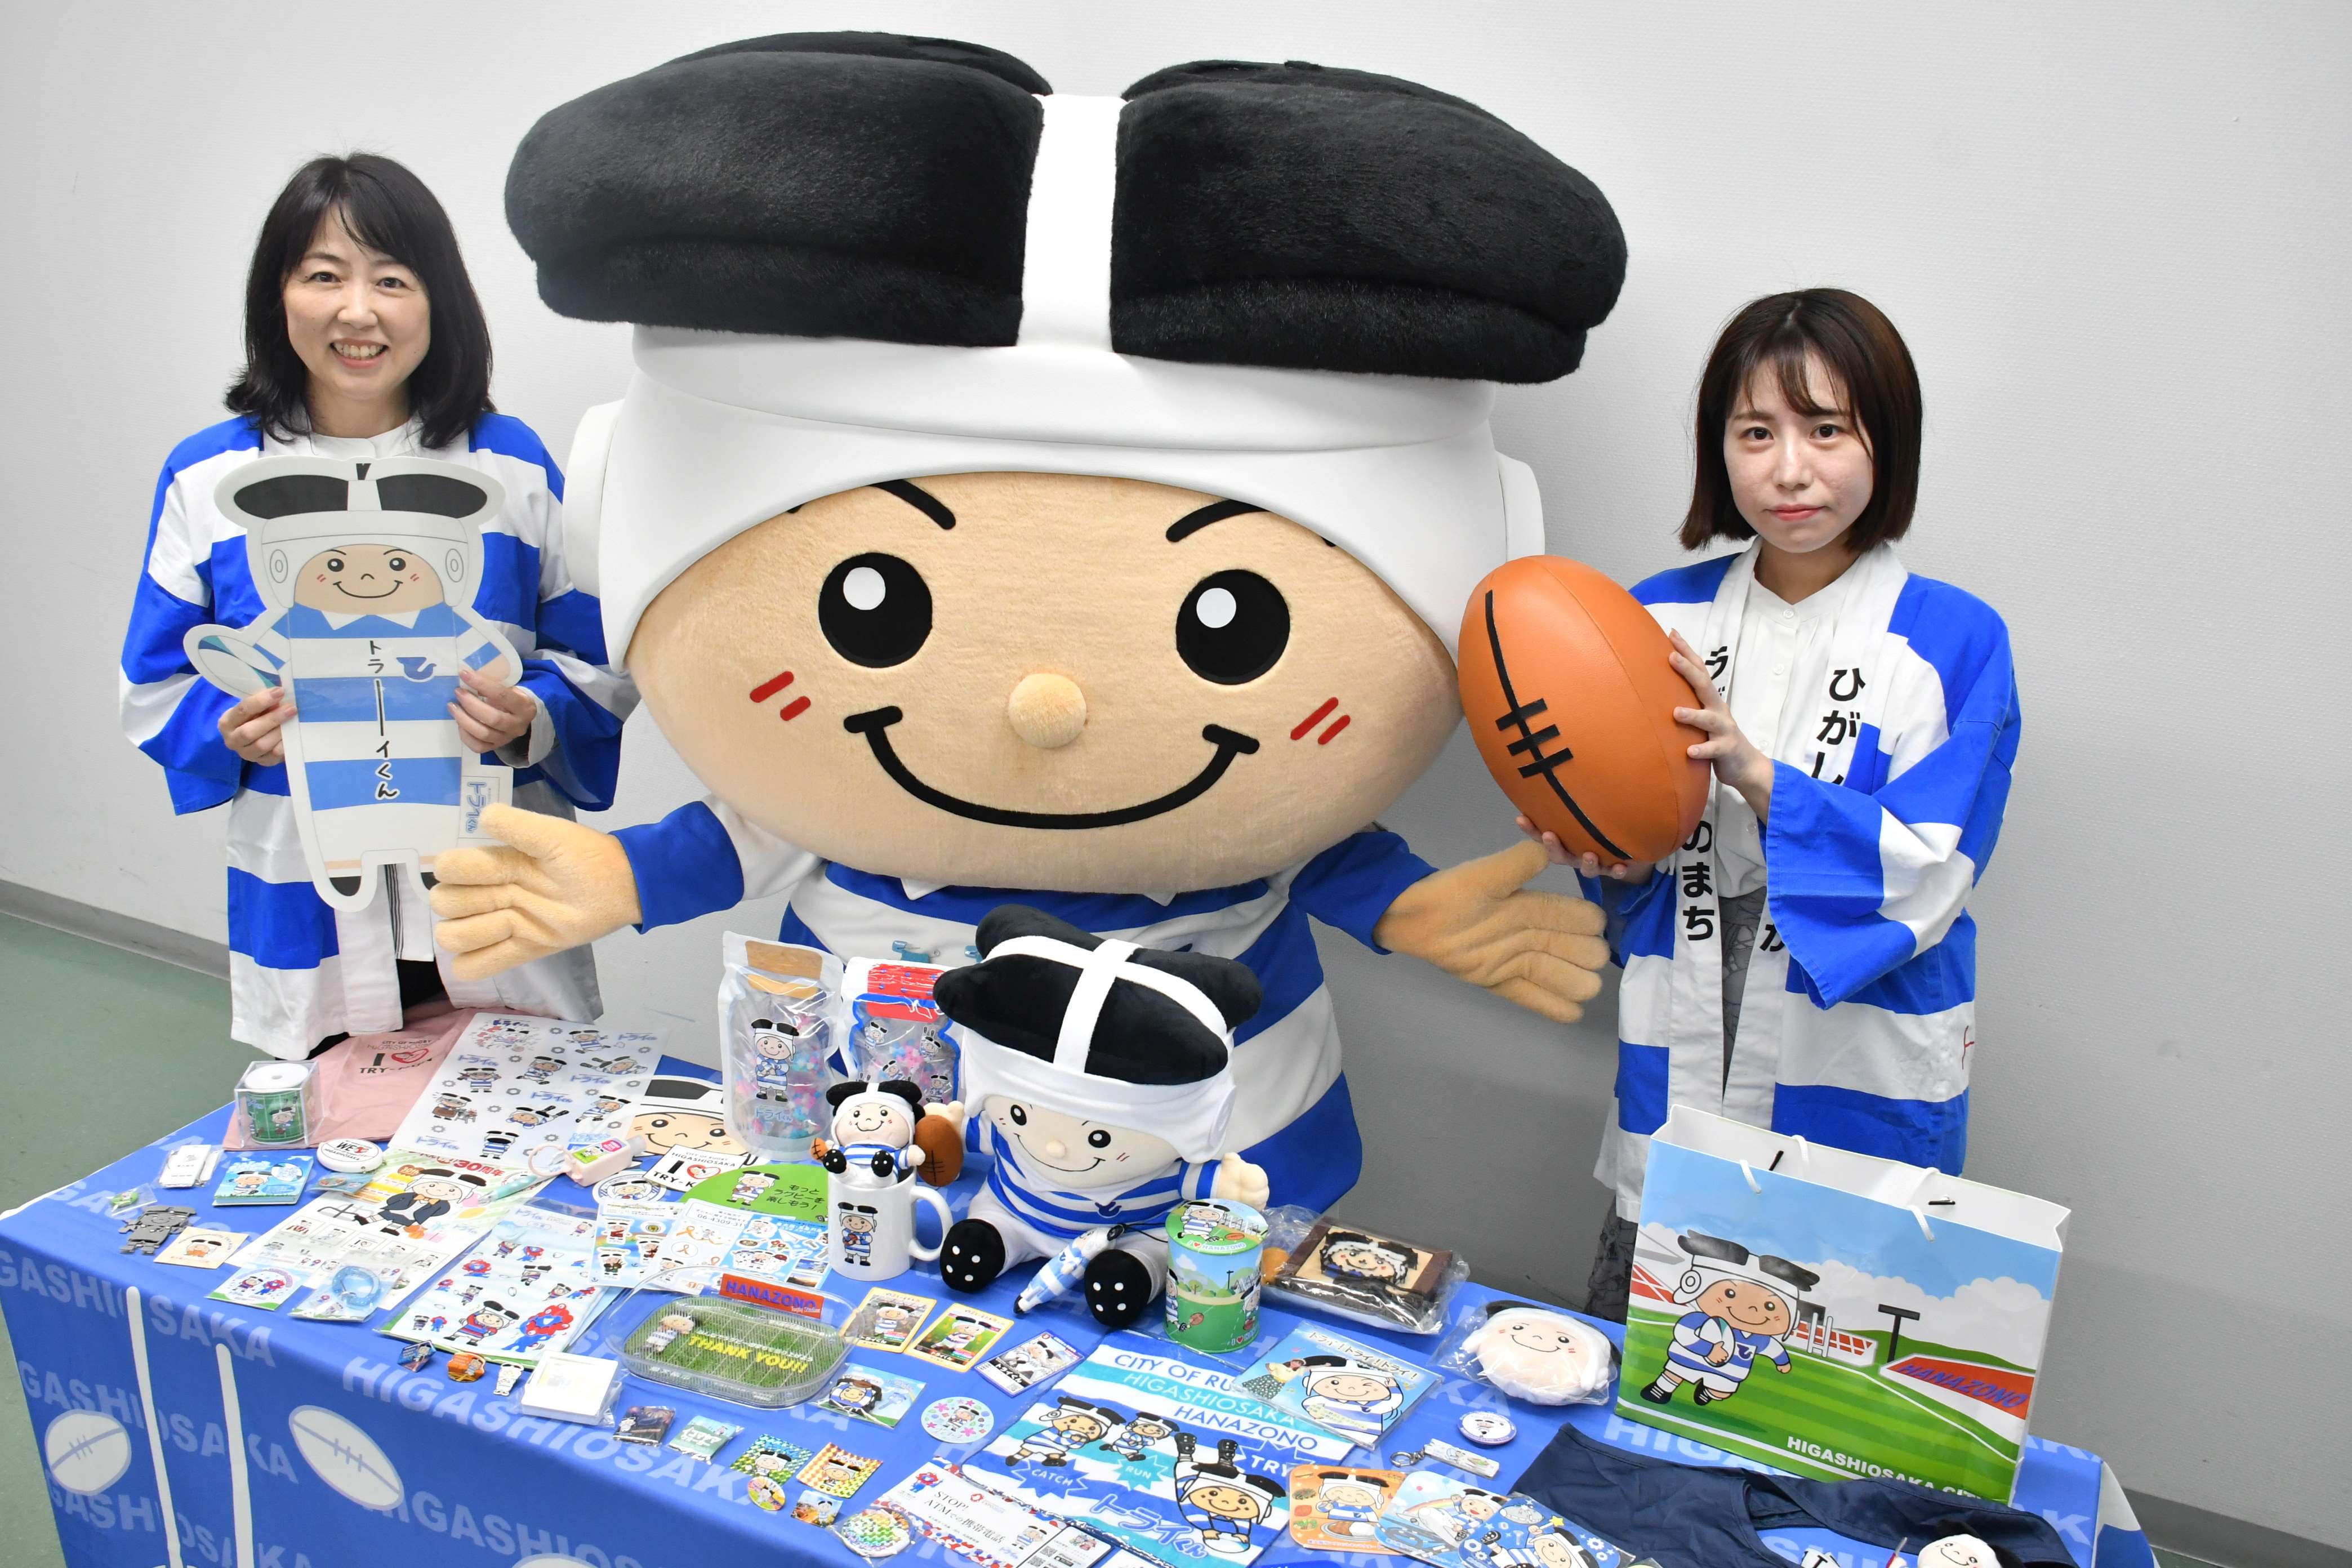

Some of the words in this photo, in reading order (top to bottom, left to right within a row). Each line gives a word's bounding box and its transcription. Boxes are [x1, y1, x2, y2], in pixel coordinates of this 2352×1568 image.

[373, 1053, 385, 1066] I
[337, 1142, 357, 1151] WE
[667, 1160, 685, 1174] I
[672, 1152, 736, 1167] HIGASHIOSAKA
[653, 1171, 697, 1188] TRY-K
[790, 1184, 819, 1195] もっと
[1202, 1242, 1246, 1251] HANAZONO
[726, 1280, 817, 1309] HANAZONO
[688, 1335, 752, 1360] THANK
[1114, 1354, 1157, 1372] CITY
[1168, 1365, 1197, 1382] OF
[1895, 1362, 2029, 1408] HANAZONO
[1123, 1372, 1296, 1424] HIGASHIOSAKA
[1174, 1405, 1318, 1451] HANAZONO
[1031, 1468, 1072, 1486] CATCH
[1126, 1465, 1151, 1478] RUN
[934, 1491, 969, 1512] STOP!
[1089, 1494, 1209, 1558] トライくん
